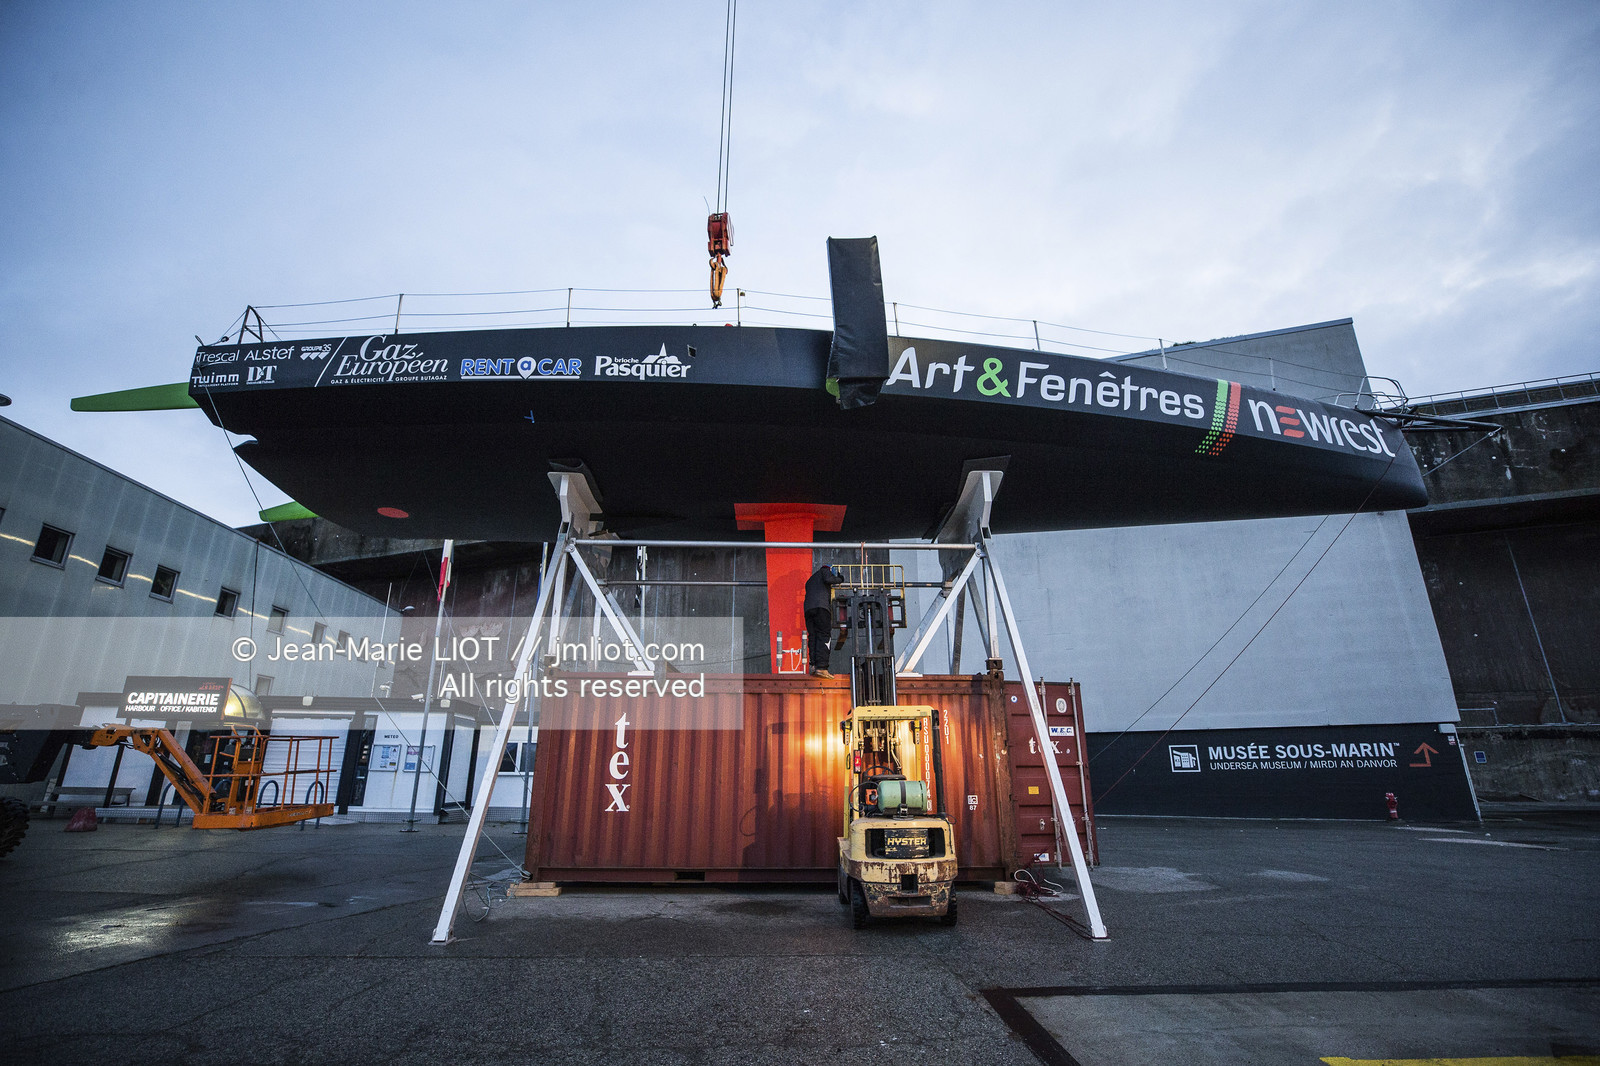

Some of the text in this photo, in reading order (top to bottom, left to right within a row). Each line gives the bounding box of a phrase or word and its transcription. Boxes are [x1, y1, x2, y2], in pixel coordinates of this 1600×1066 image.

[196, 349, 240, 363] Trescal
[360, 335, 418, 361] Gaz
[334, 352, 449, 382] Européen
[460, 358, 516, 376] RENT
[537, 358, 582, 376] CAR
[594, 355, 692, 381] Pasquier
[885, 346, 1205, 420] Art & Fenêtres
[127, 692, 220, 706] CAPITAINERIE
[1208, 743, 1271, 760] MUSÉE
[605, 711, 631, 812] tex
[1209, 762, 1259, 771] UNDERSEA
[1260, 760, 1302, 770] MUSEUM
[1310, 760, 1338, 769] MIRDI
[1340, 760, 1354, 768] AN
[1356, 759, 1398, 768] DANVOR
[887, 837, 927, 846] HYSTER
